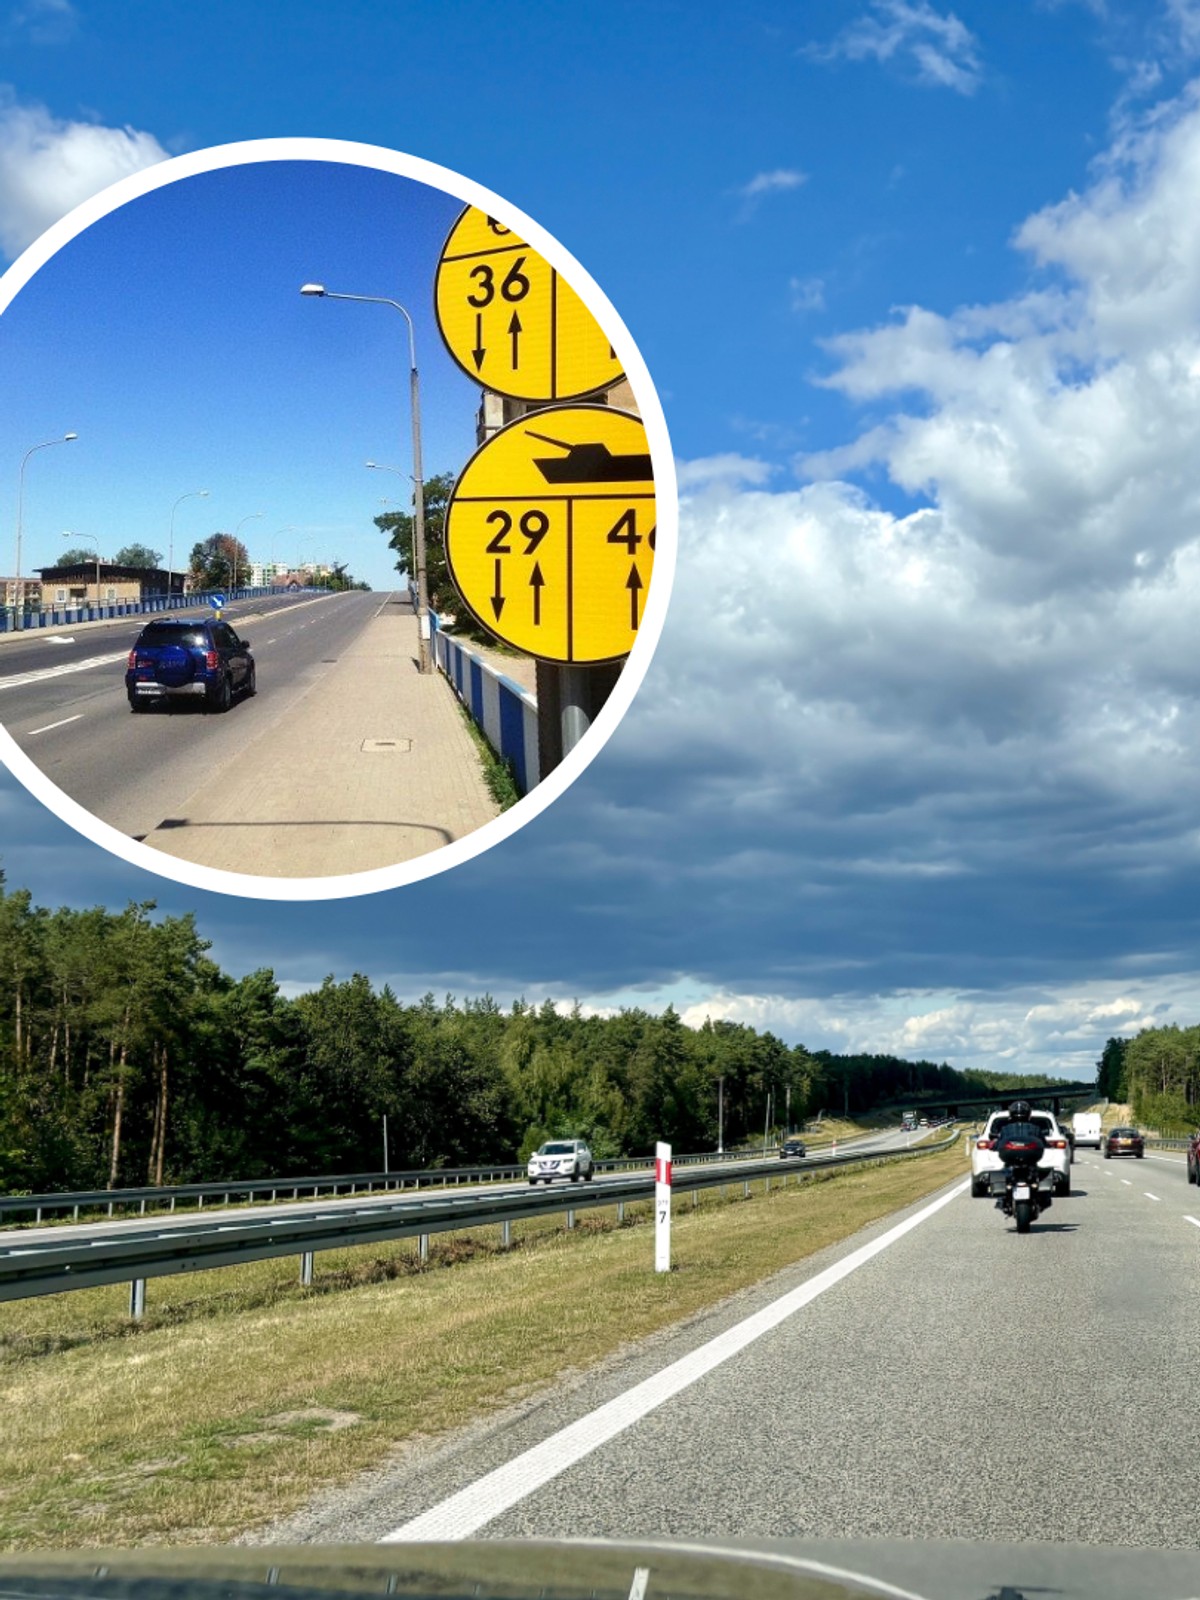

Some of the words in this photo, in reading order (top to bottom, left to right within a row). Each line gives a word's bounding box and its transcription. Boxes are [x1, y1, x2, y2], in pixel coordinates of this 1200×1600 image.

[467, 257, 530, 308] 36
[485, 509, 550, 555] 29
[606, 508, 657, 555] 4
[659, 1211, 667, 1223] 7
